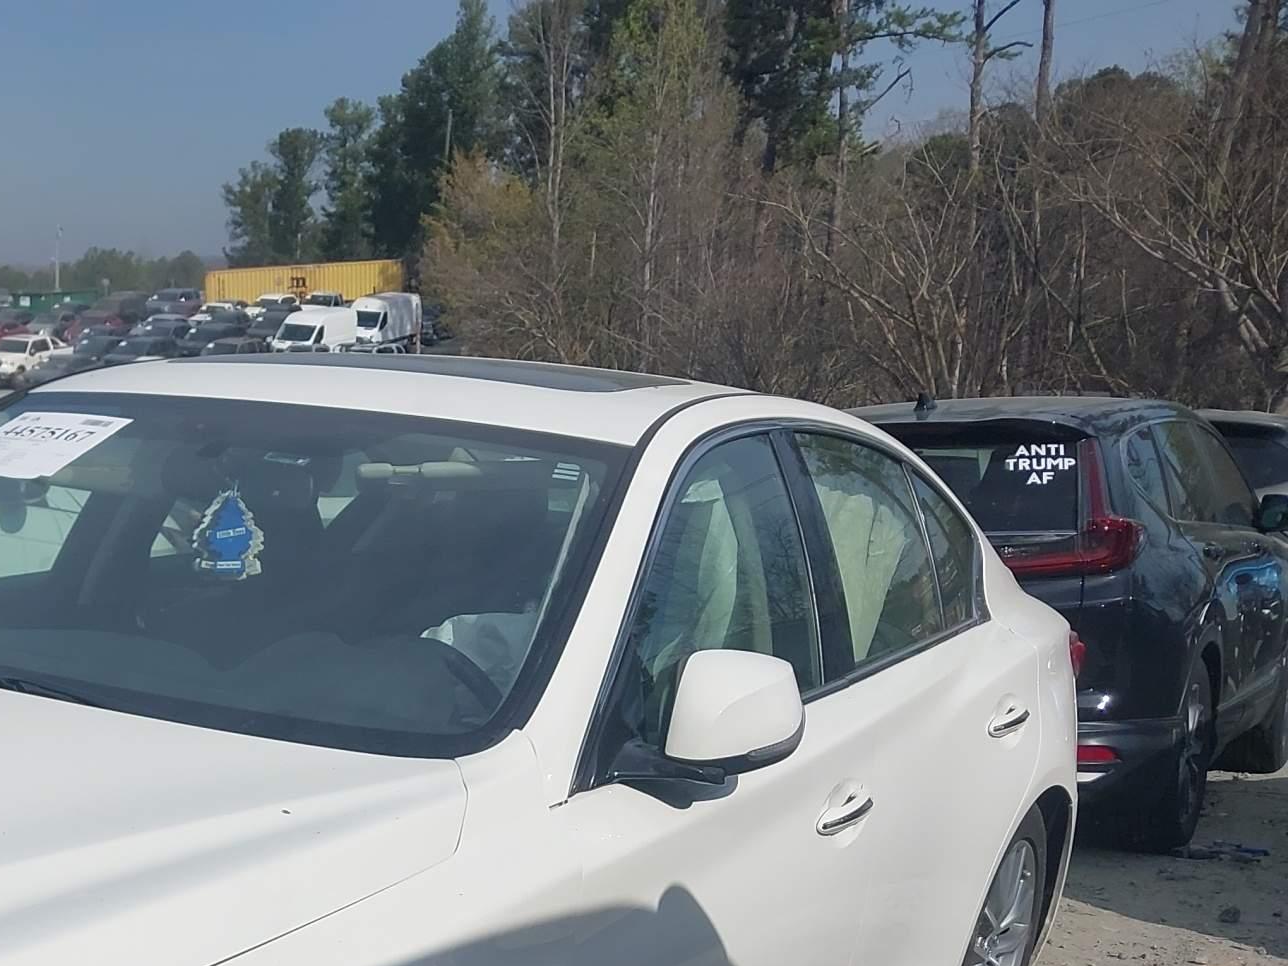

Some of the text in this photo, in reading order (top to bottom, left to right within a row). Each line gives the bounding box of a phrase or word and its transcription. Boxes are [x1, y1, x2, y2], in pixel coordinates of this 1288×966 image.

[3, 424, 97, 443] 44575167
[1015, 444, 1065, 456] ANTI
[1005, 457, 1076, 471] TRUMP
[1026, 472, 1055, 485] AF
